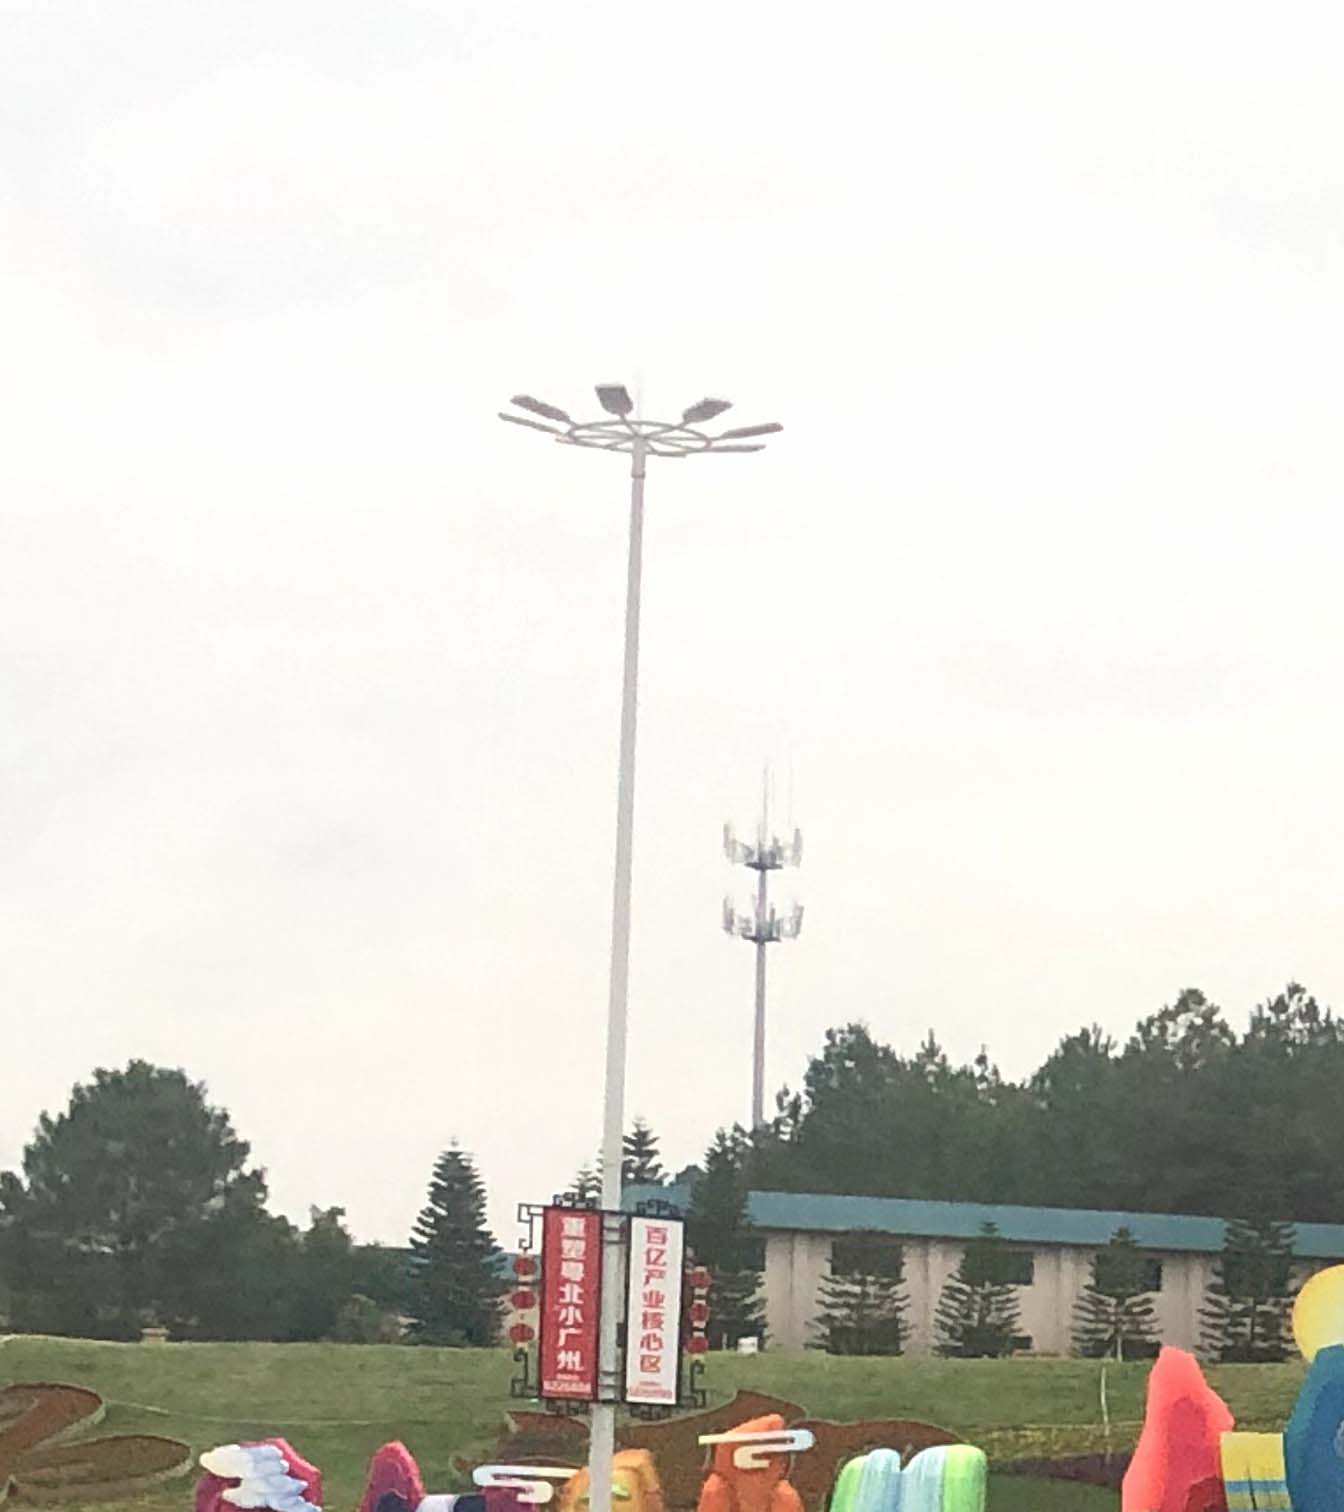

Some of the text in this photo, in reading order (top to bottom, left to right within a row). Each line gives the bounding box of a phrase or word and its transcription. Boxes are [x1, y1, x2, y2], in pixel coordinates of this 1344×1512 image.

[639, 1225, 669, 1374] 百亿产业核心区
